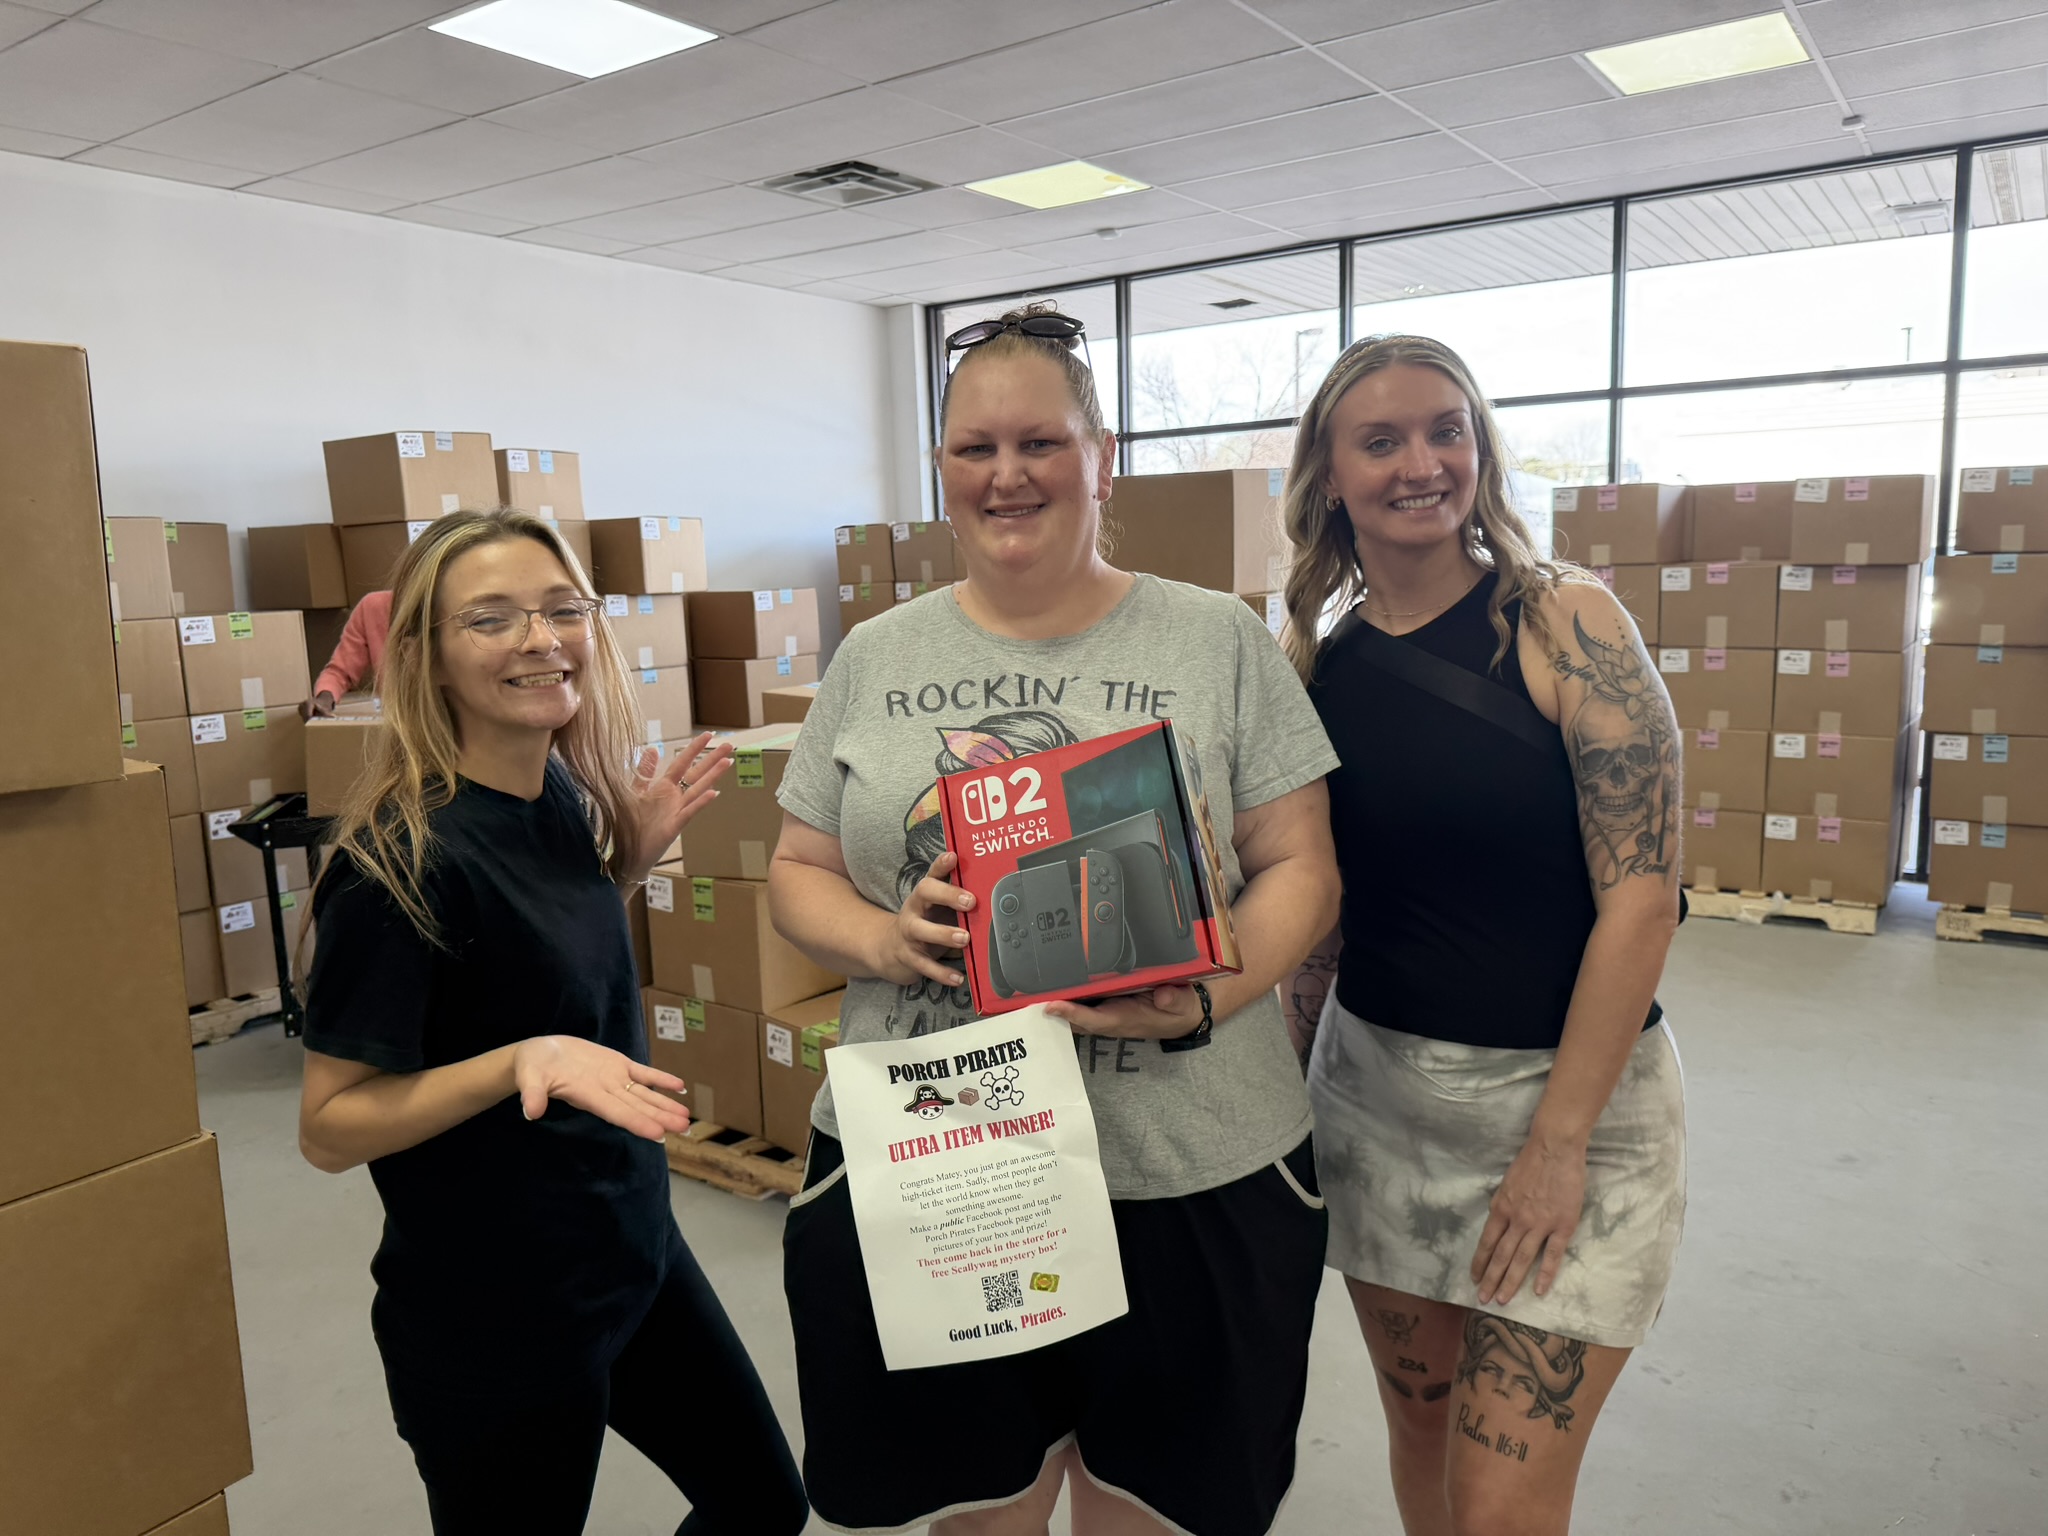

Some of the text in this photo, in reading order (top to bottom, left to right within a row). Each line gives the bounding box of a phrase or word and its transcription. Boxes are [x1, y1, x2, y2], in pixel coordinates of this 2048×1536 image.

[885, 673, 1177, 720] ROCKIN' THE
[972, 817, 1047, 841] NINTENDO
[973, 826, 1050, 857] SWITCH
[1041, 931, 1072, 944] SWITCH
[887, 1037, 1027, 1085] PORCH PIRATES
[887, 1108, 1055, 1163] ULTRA ITEM WINNER!
[899, 1177, 935, 1190] Congrats
[936, 1171, 963, 1182] Matey,
[963, 1167, 979, 1178] you
[980, 1163, 994, 1174] just
[995, 1159, 1008, 1170] got
[1020, 1150, 1056, 1163] awesome
[901, 1160, 1058, 1203] high-ticket item. Sadly, most people don't
[919, 1175, 1045, 1210] let the world know when they get
[945, 1193, 1024, 1216] something awesome.
[909, 1224, 931, 1234] Make
[939, 1216, 965, 1231] public
[965, 1208, 1003, 1223] Facebook
[1004, 1204, 1020, 1216] post
[1022, 1199, 1036, 1210] and
[1037, 1198, 1050, 1206] tag
[1050, 1194, 1062, 1202] the
[925, 1207, 1052, 1243] Porch Pirates Facebook page with
[916, 1258, 941, 1267] Then
[943, 1253, 967, 1263] come
[969, 1245, 992, 1258] back
[993, 1243, 1003, 1252] in
[1005, 1240, 1020, 1250] the
[1022, 1234, 1044, 1246] store
[1046, 1229, 1060, 1239] for
[932, 1219, 1048, 1255] pictures of your box and prize!
[931, 1241, 1058, 1278] free Scallywag mystery box!
[949, 1306, 1066, 1342] Good Luck, Pirates.
[1456, 1402, 1490, 1447] Psalm
